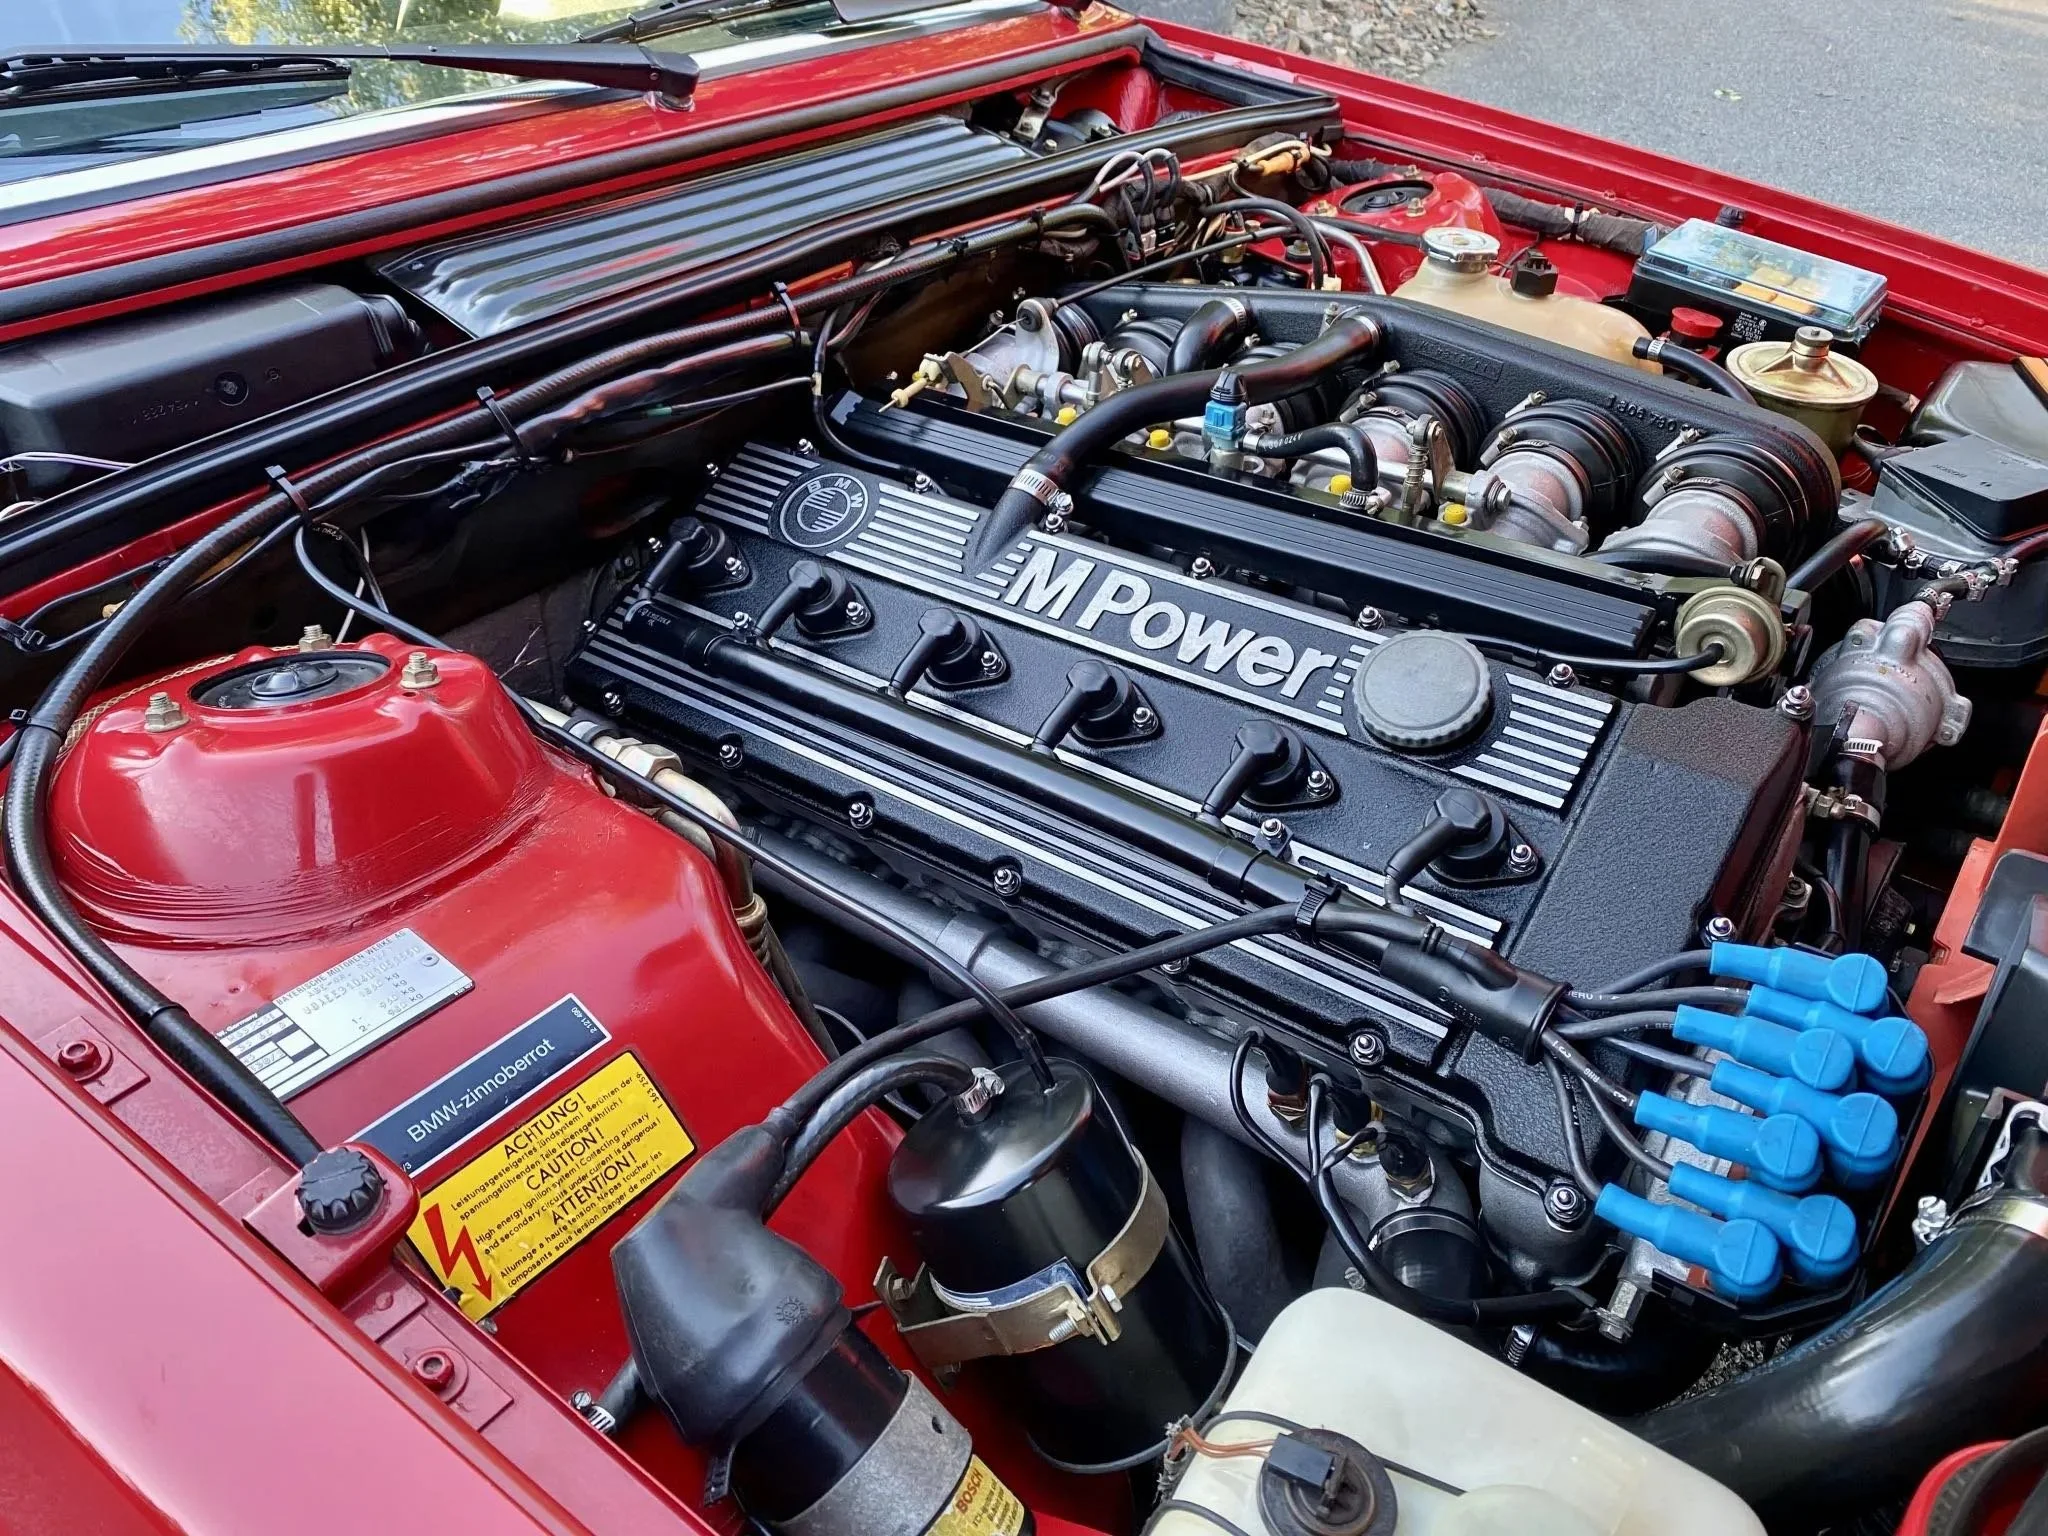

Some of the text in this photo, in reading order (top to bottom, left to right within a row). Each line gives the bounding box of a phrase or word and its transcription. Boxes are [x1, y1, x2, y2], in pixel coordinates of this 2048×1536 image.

[807, 477, 864, 508] BMW
[1004, 546, 1338, 699] M Power
[405, 1036, 556, 1143] BMW-zinnoberrot
[645, 1087, 660, 1103] 363
[449, 1145, 538, 1211] Leistungsgesteigertes
[585, 1086, 620, 1112] Berühren
[619, 1075, 632, 1088] der
[459, 1159, 541, 1221] spannungsführenden
[539, 1146, 557, 1160] Teile
[474, 1228, 496, 1245] High
[495, 1206, 521, 1230] energy
[620, 1111, 648, 1138] primary
[483, 1238, 500, 1255] and
[499, 1208, 539, 1243] secondary
[540, 1188, 568, 1212] circuits
[567, 1172, 589, 1190] under
[500, 1247, 538, 1279] Allumage
[543, 1224, 569, 1243] haute
[621, 1159, 649, 1183] toucher
[648, 1150, 663, 1161] les
[553, 1234, 573, 1251] sous
[600, 1191, 627, 1214] Danger
[627, 1182, 639, 1193] de
[955, 1468, 984, 1515] BOSCH
